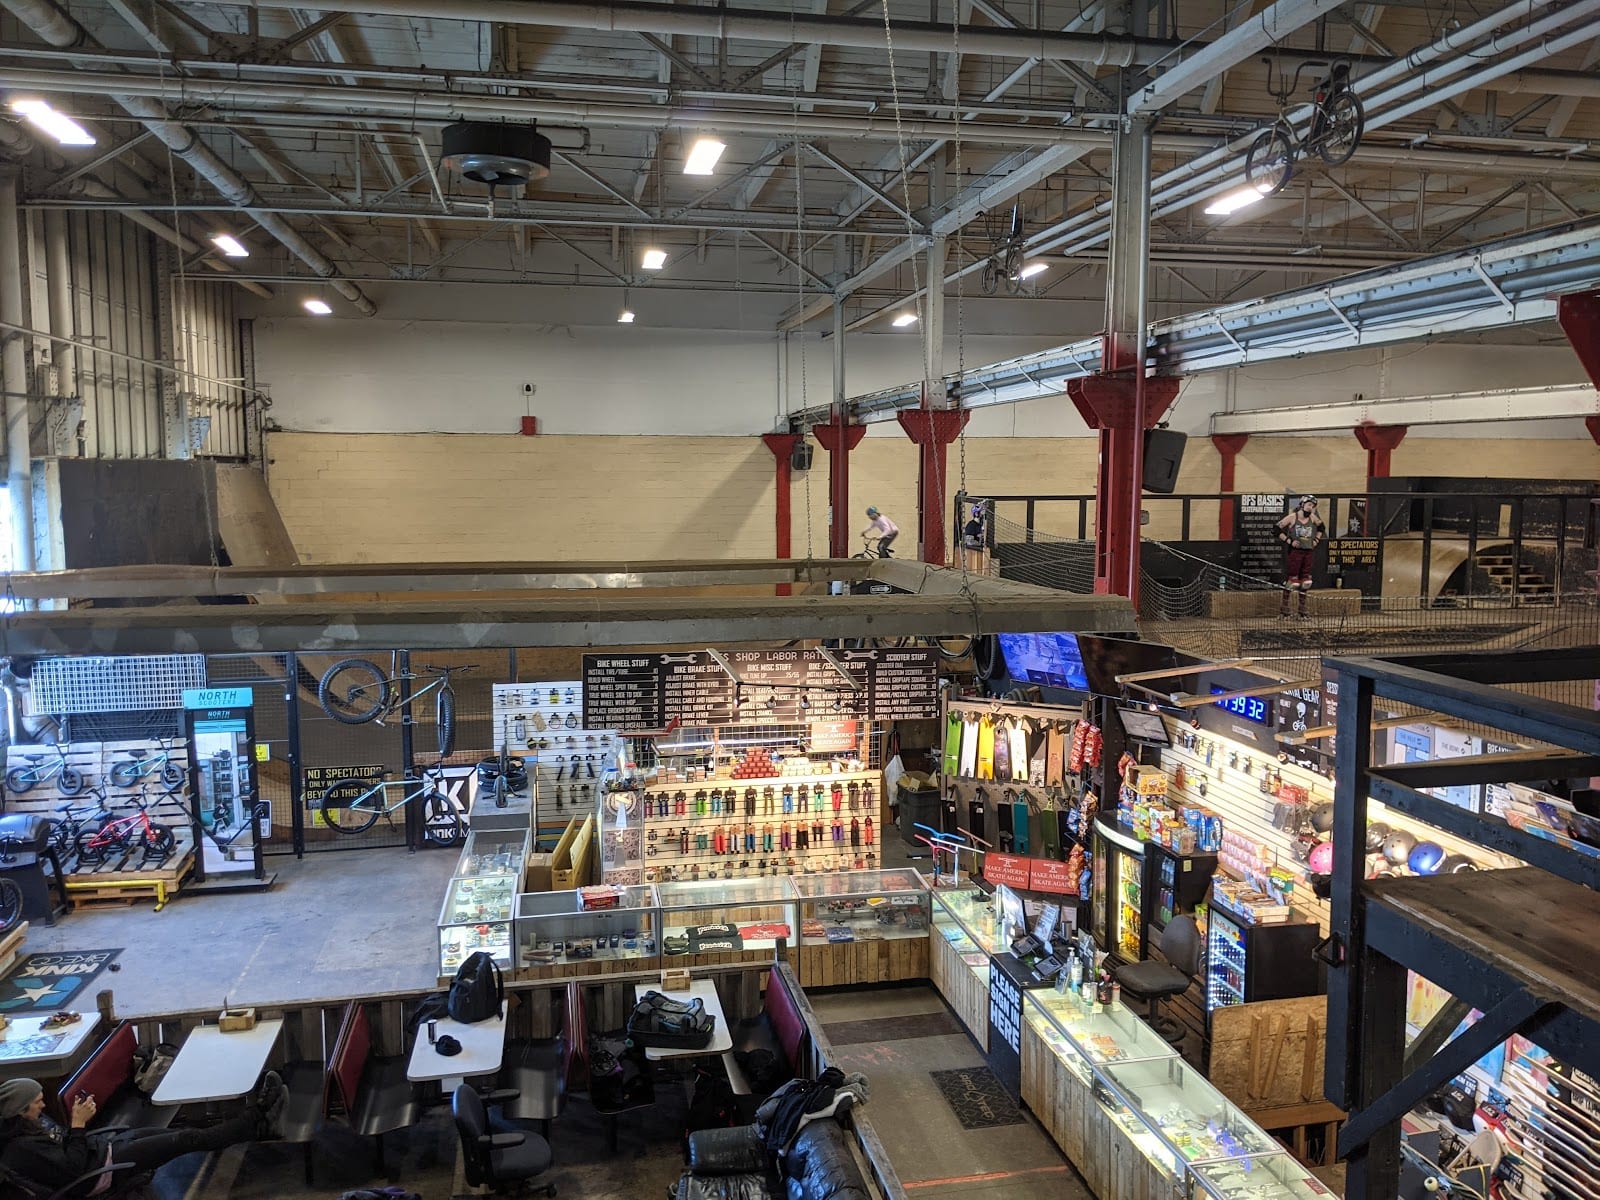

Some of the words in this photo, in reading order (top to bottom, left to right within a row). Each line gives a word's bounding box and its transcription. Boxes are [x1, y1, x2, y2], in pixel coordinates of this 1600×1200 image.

[1242, 495, 1256, 505] BFS
[1257, 495, 1284, 505] BASICS
[1340, 541, 1378, 549] SPECTATORS
[736, 653, 760, 661] SHOP
[767, 652, 797, 660] LABOR
[198, 691, 237, 700] NORTH
[1303, 688, 1319, 704] GEAR
[1231, 696, 1246, 714] 39
[1248, 699, 1264, 720] 32
[308, 770, 320, 779] NO
[342, 788, 358, 798] THIS
[1003, 868, 1028, 876] AMERICA
[17, 963, 100, 977] KINK
[991, 963, 1020, 1010] PLEASE
[991, 983, 1010, 1017] SIGN
[1011, 1006, 1019, 1029] IN
[991, 1000, 1020, 1056] HERE
